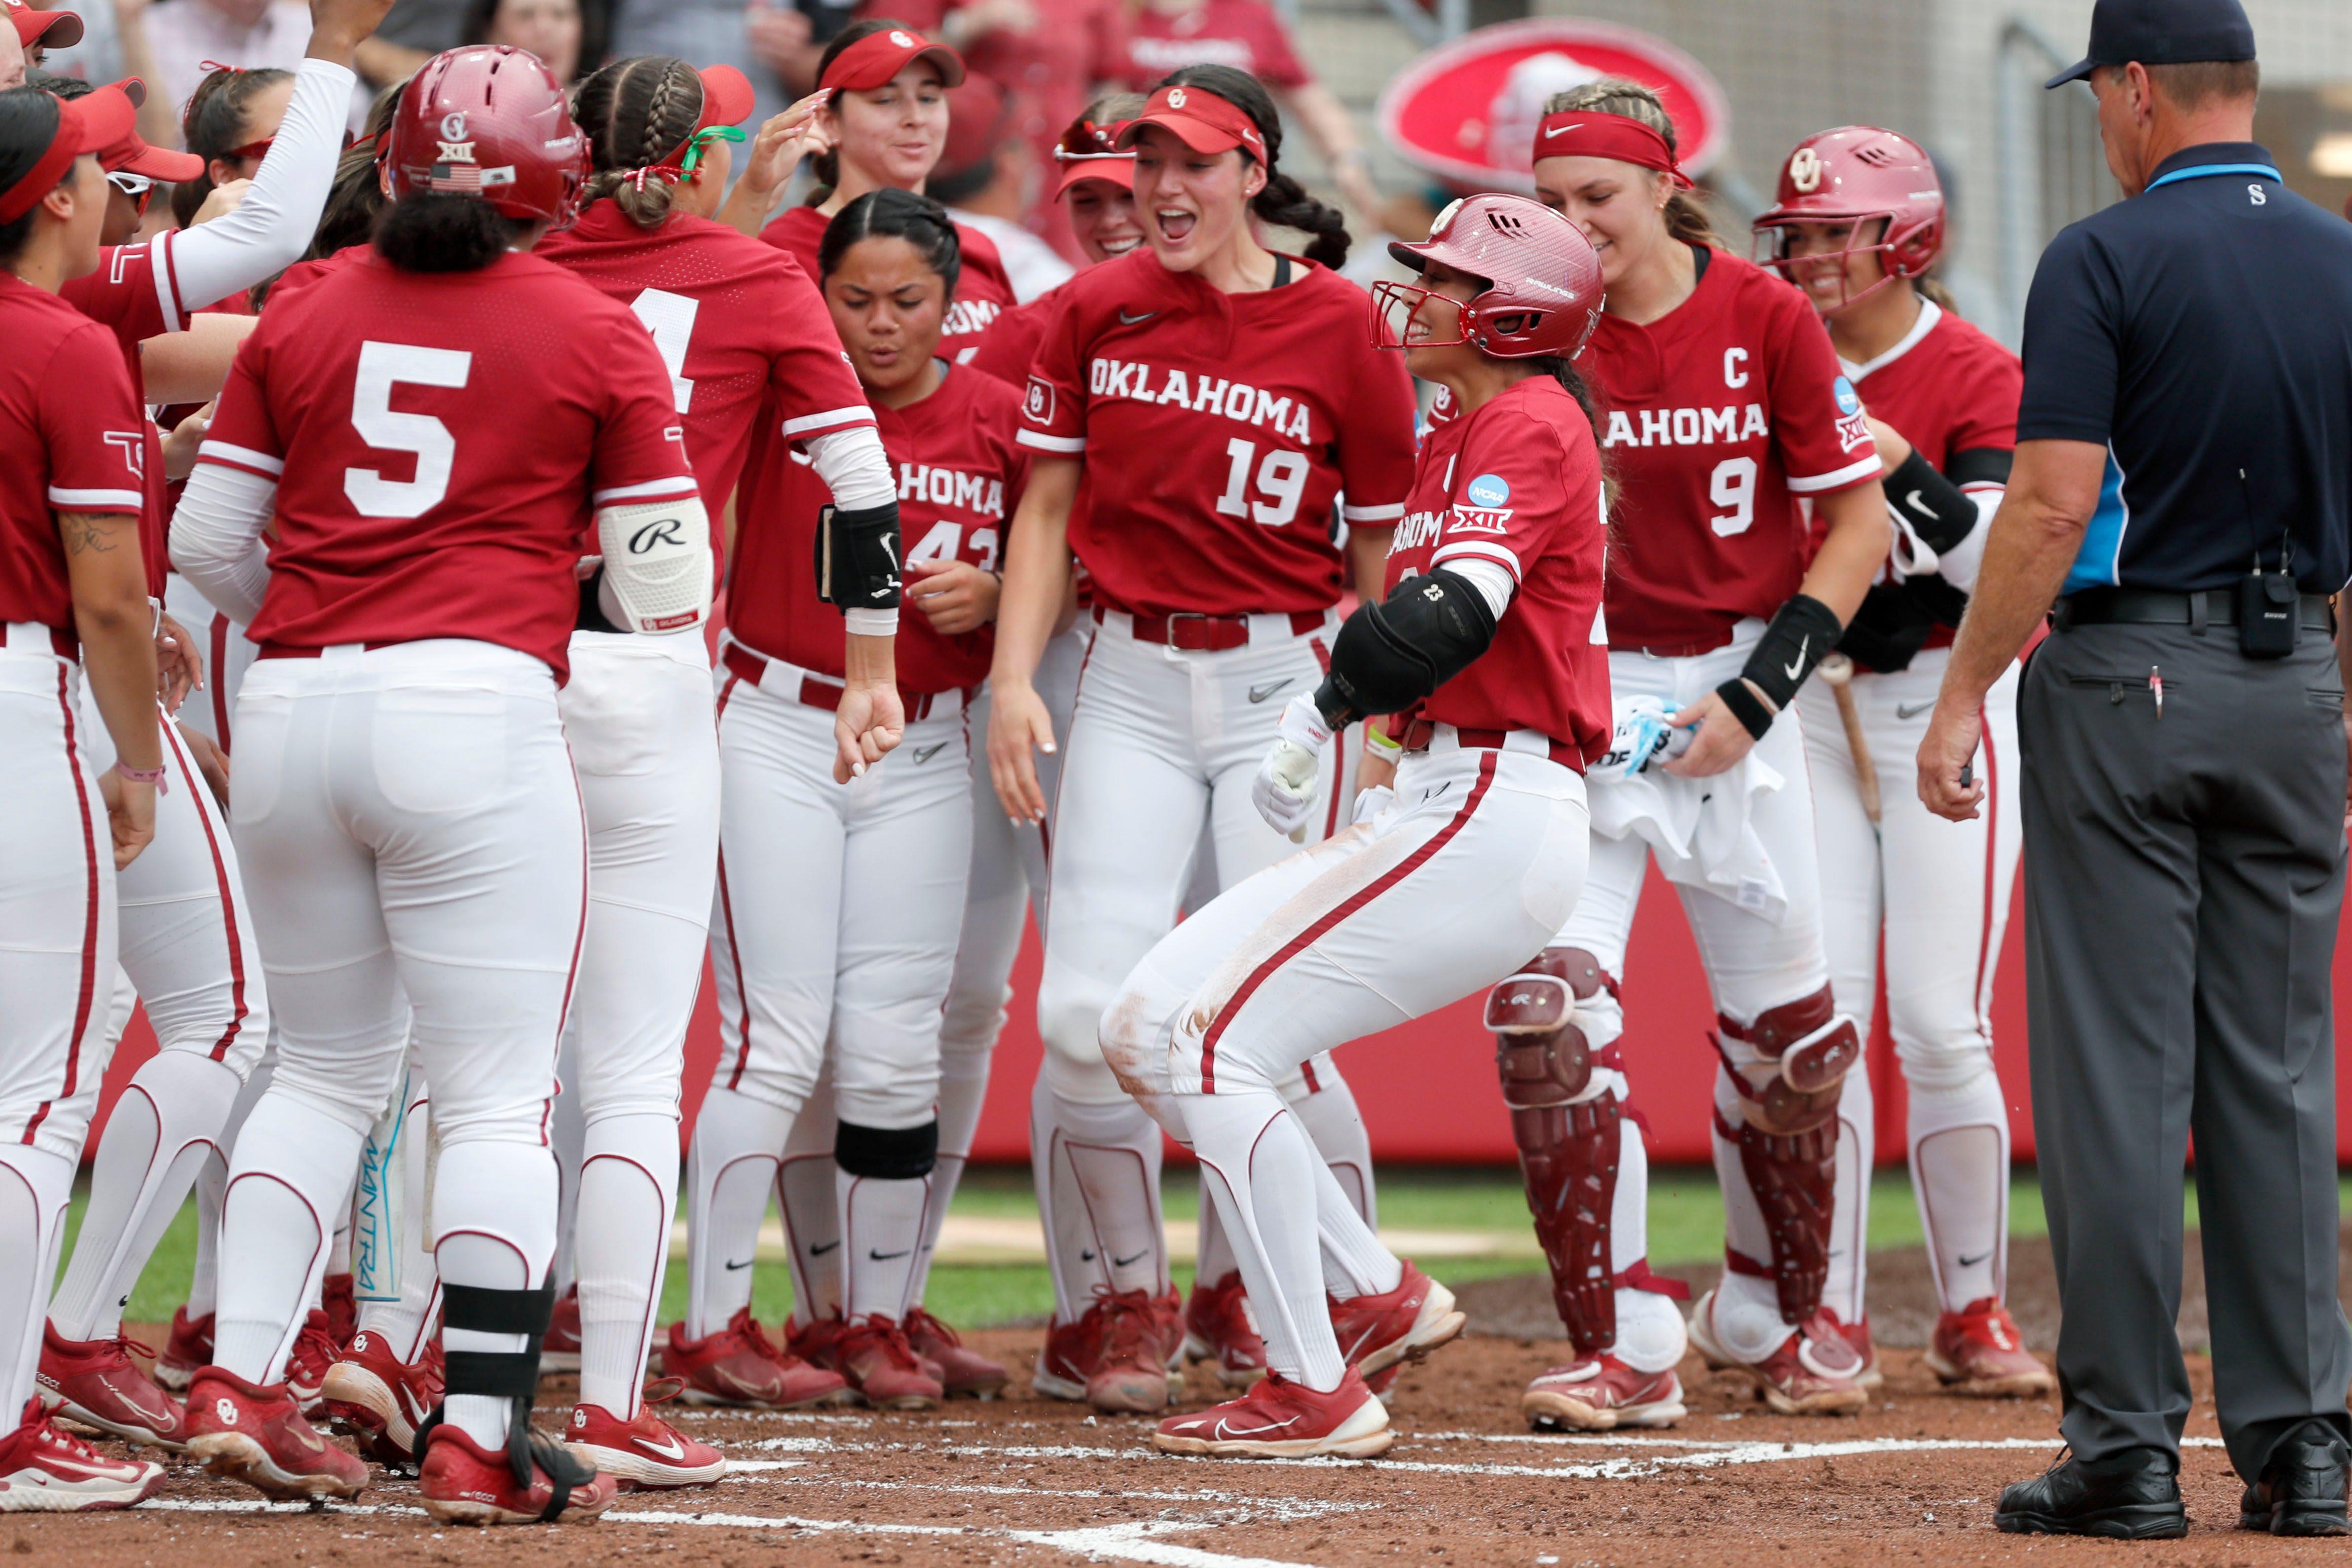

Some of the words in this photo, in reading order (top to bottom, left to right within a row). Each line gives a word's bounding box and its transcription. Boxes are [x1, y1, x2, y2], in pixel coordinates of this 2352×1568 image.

[1790, 148, 1822, 193] OU
[2247, 184, 2266, 205] S
[1525, 277, 1575, 299] RAWLINGS
[1724, 347, 1749, 389] C
[1030, 385, 1044, 412] OU
[1090, 358, 1311, 445] OKLAHOMA
[343, 340, 472, 519] 5
[1216, 438, 1310, 527] 19
[1472, 486, 1505, 503] NCAA
[1710, 456, 1757, 538] 9
[1423, 584, 1444, 601] 23
[353, 1334, 369, 1352] OU
[217, 1398, 238, 1425] OU
[574, 1409, 587, 1428] OU
